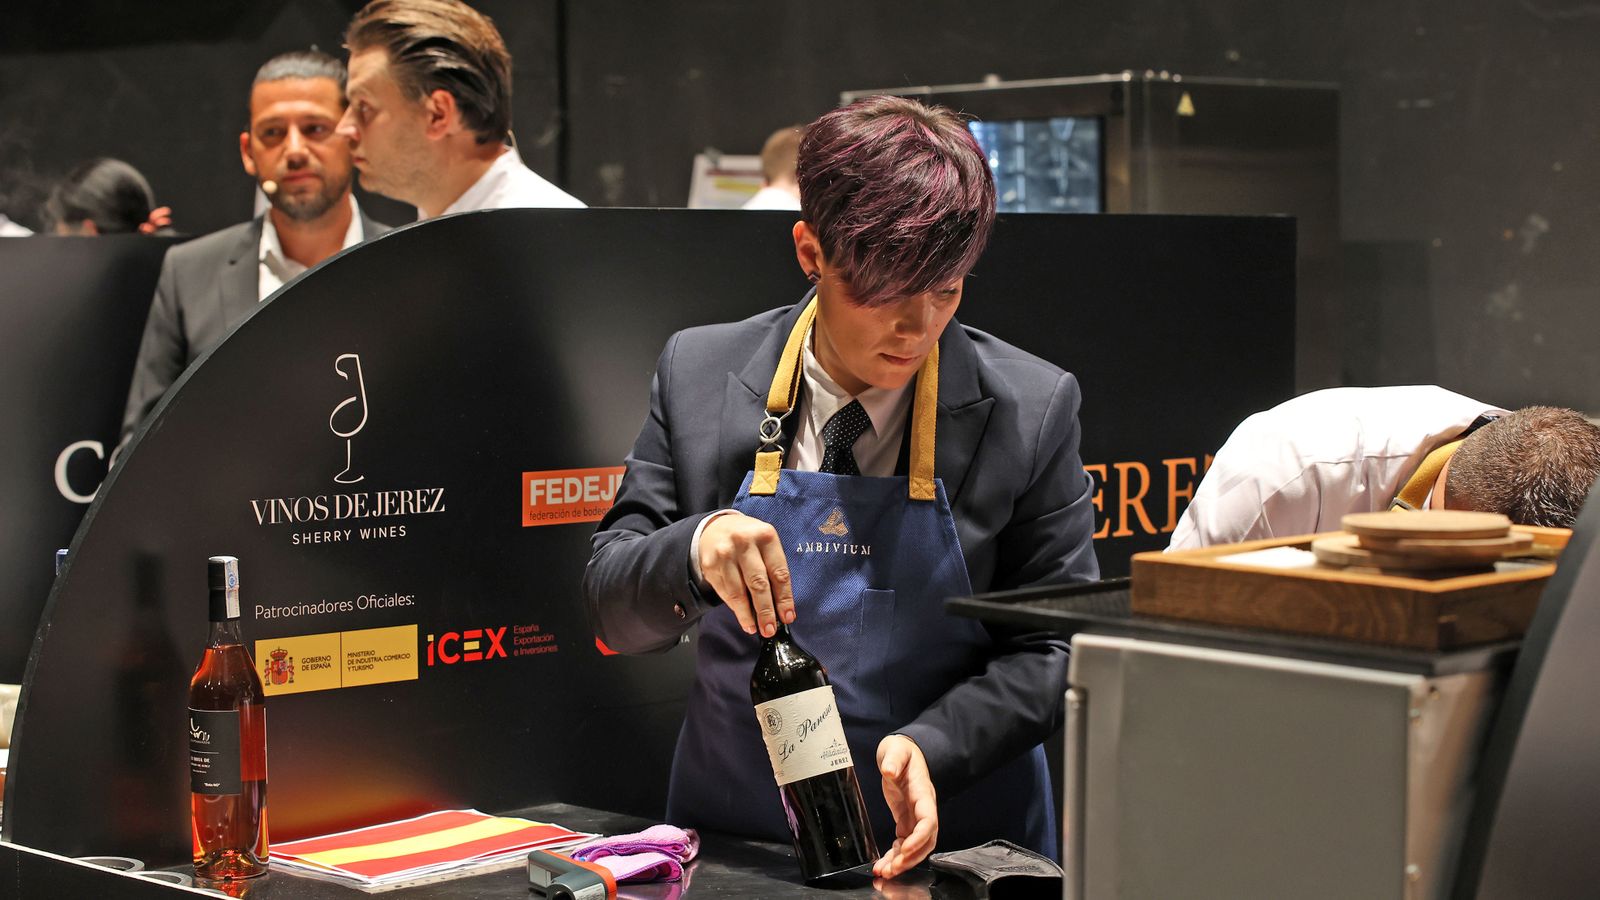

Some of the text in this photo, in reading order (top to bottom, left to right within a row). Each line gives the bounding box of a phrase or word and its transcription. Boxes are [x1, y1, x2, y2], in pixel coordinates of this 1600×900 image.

[54, 432, 134, 504] C
[250, 487, 446, 526] VINOS DE JEREZ
[529, 508, 570, 521] federación
[571, 508, 581, 518] de
[292, 525, 407, 545] SHERRY WINES
[796, 541, 871, 556] AMBIVIUM
[255, 592, 415, 620] Patrocinadores Oficiales:
[514, 624, 540, 635] España
[514, 633, 555, 646] Exportación
[347, 649, 376, 659] MINISTERIO
[383, 652, 411, 662] COMERCIO
[513, 644, 558, 657] e Inversiones
[301, 654, 332, 665] GOBIERNO
[310, 662, 332, 671] ESPAÑA
[352, 663, 374, 672] TURISMO
[778, 739, 795, 764] La
